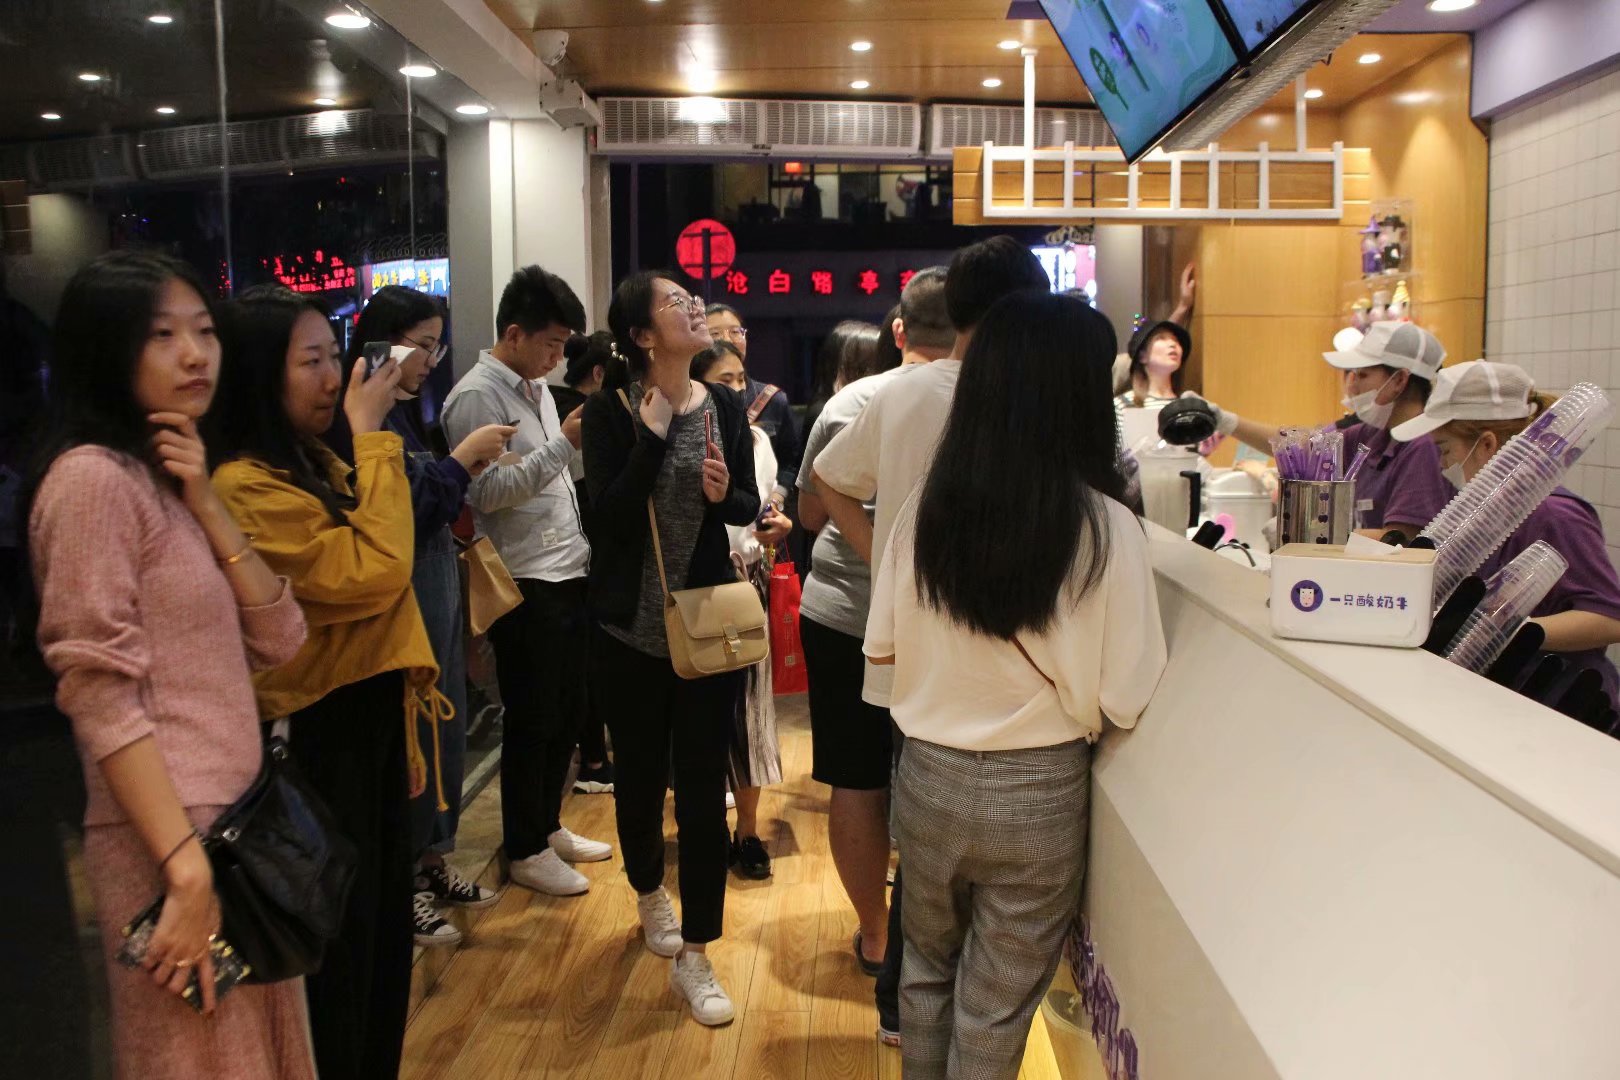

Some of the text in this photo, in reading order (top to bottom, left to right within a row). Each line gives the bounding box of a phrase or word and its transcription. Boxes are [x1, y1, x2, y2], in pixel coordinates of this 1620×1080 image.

[1329, 593, 1408, 610] 一只酸奶牛
